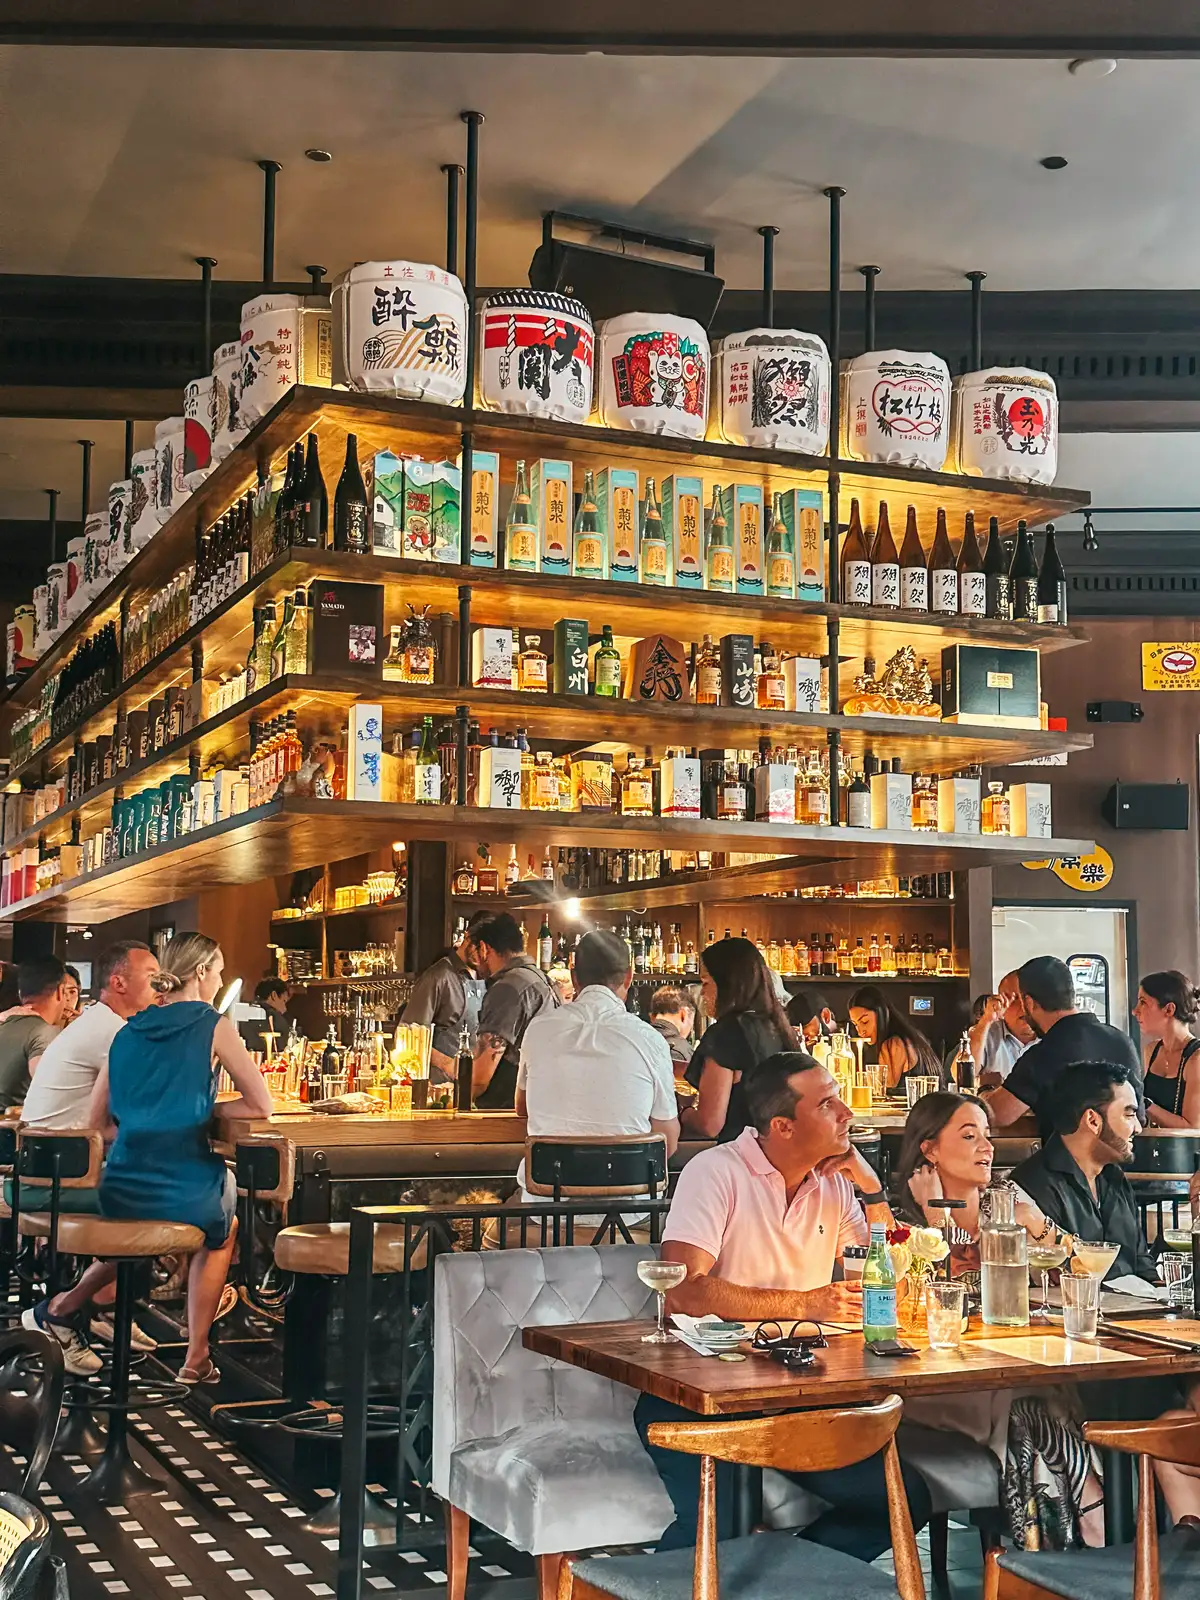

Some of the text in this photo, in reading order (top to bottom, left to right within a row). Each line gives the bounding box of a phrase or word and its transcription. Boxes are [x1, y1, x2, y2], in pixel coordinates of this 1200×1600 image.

[277, 328, 292, 385] 特別純米
[879, 388, 942, 424] 松竹梅
[1018, 398, 1040, 456] 玉乃光
[475, 491, 490, 516] 菊水
[549, 500, 564, 524] 菊水
[618, 508, 632, 531] 菊水
[682, 515, 696, 538] 菊水
[744, 523, 757, 545] 菊水
[804, 528, 817, 550] 菊水
[568, 647, 589, 695] 白州
